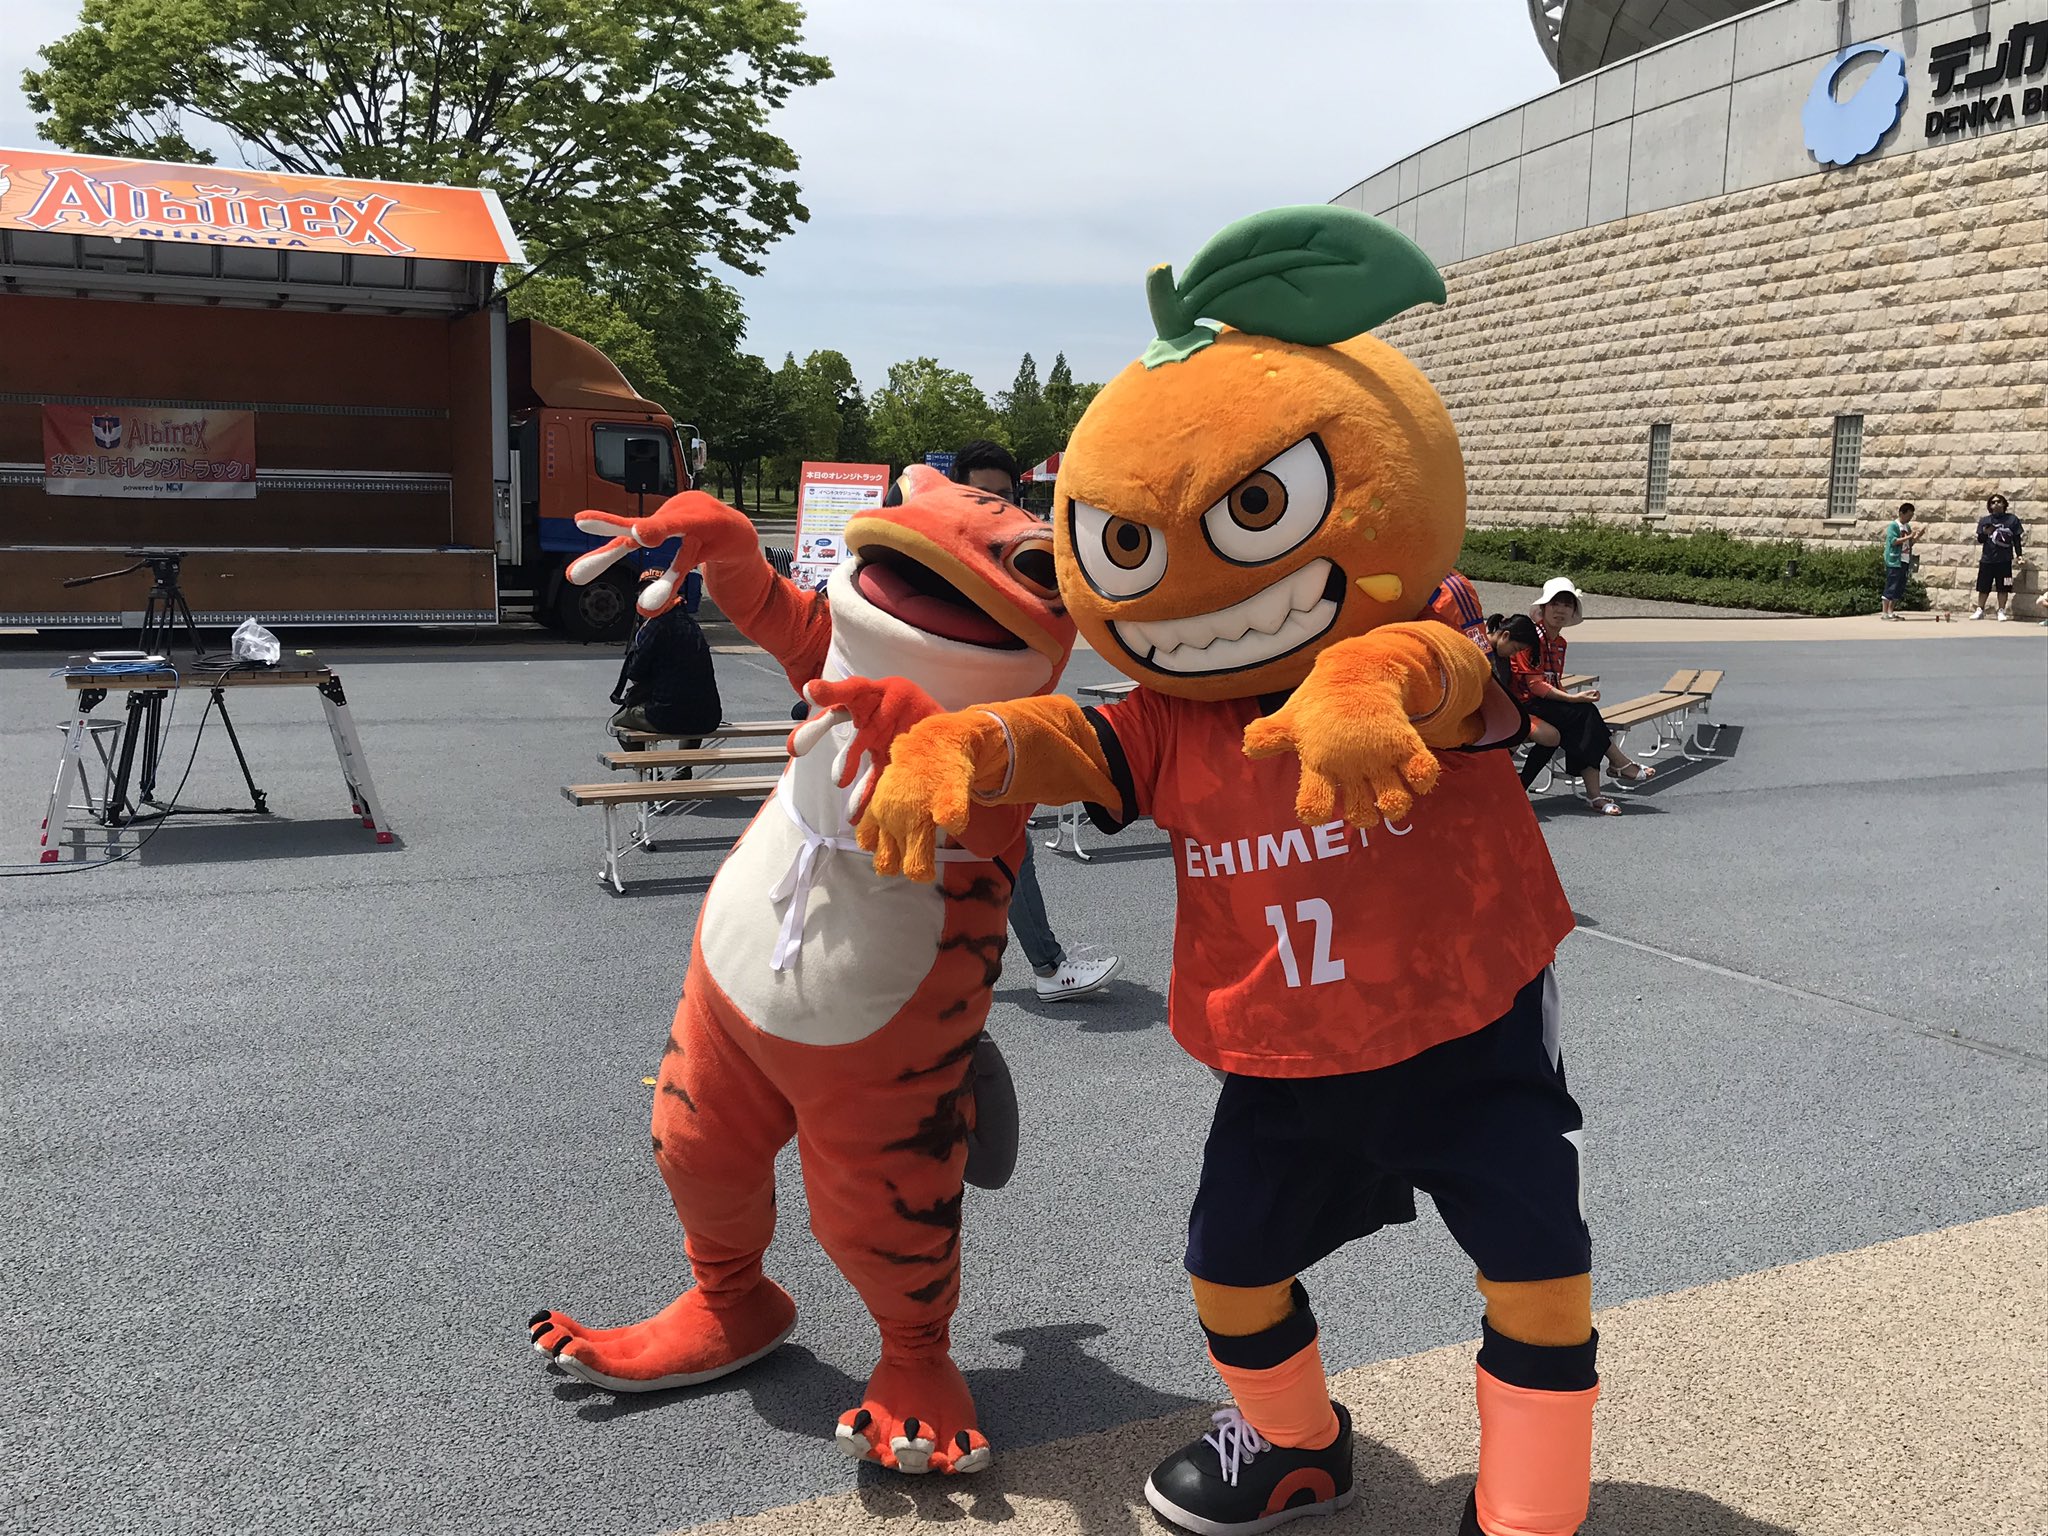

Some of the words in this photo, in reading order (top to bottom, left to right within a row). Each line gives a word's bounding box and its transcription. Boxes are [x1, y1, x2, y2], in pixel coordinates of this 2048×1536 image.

[1925, 94, 2015, 137] DENKA
[16, 168, 415, 255] Albirex
[138, 228, 309, 248] NIIGATA
[125, 416, 209, 453] Albirex
[51, 454, 96, 466] イベント
[52, 465, 97, 476] ステージ
[806, 471, 883, 482] 本日のオレンジトラック
[1185, 819, 1349, 878] EHIME
[1264, 897, 1346, 988] 12
